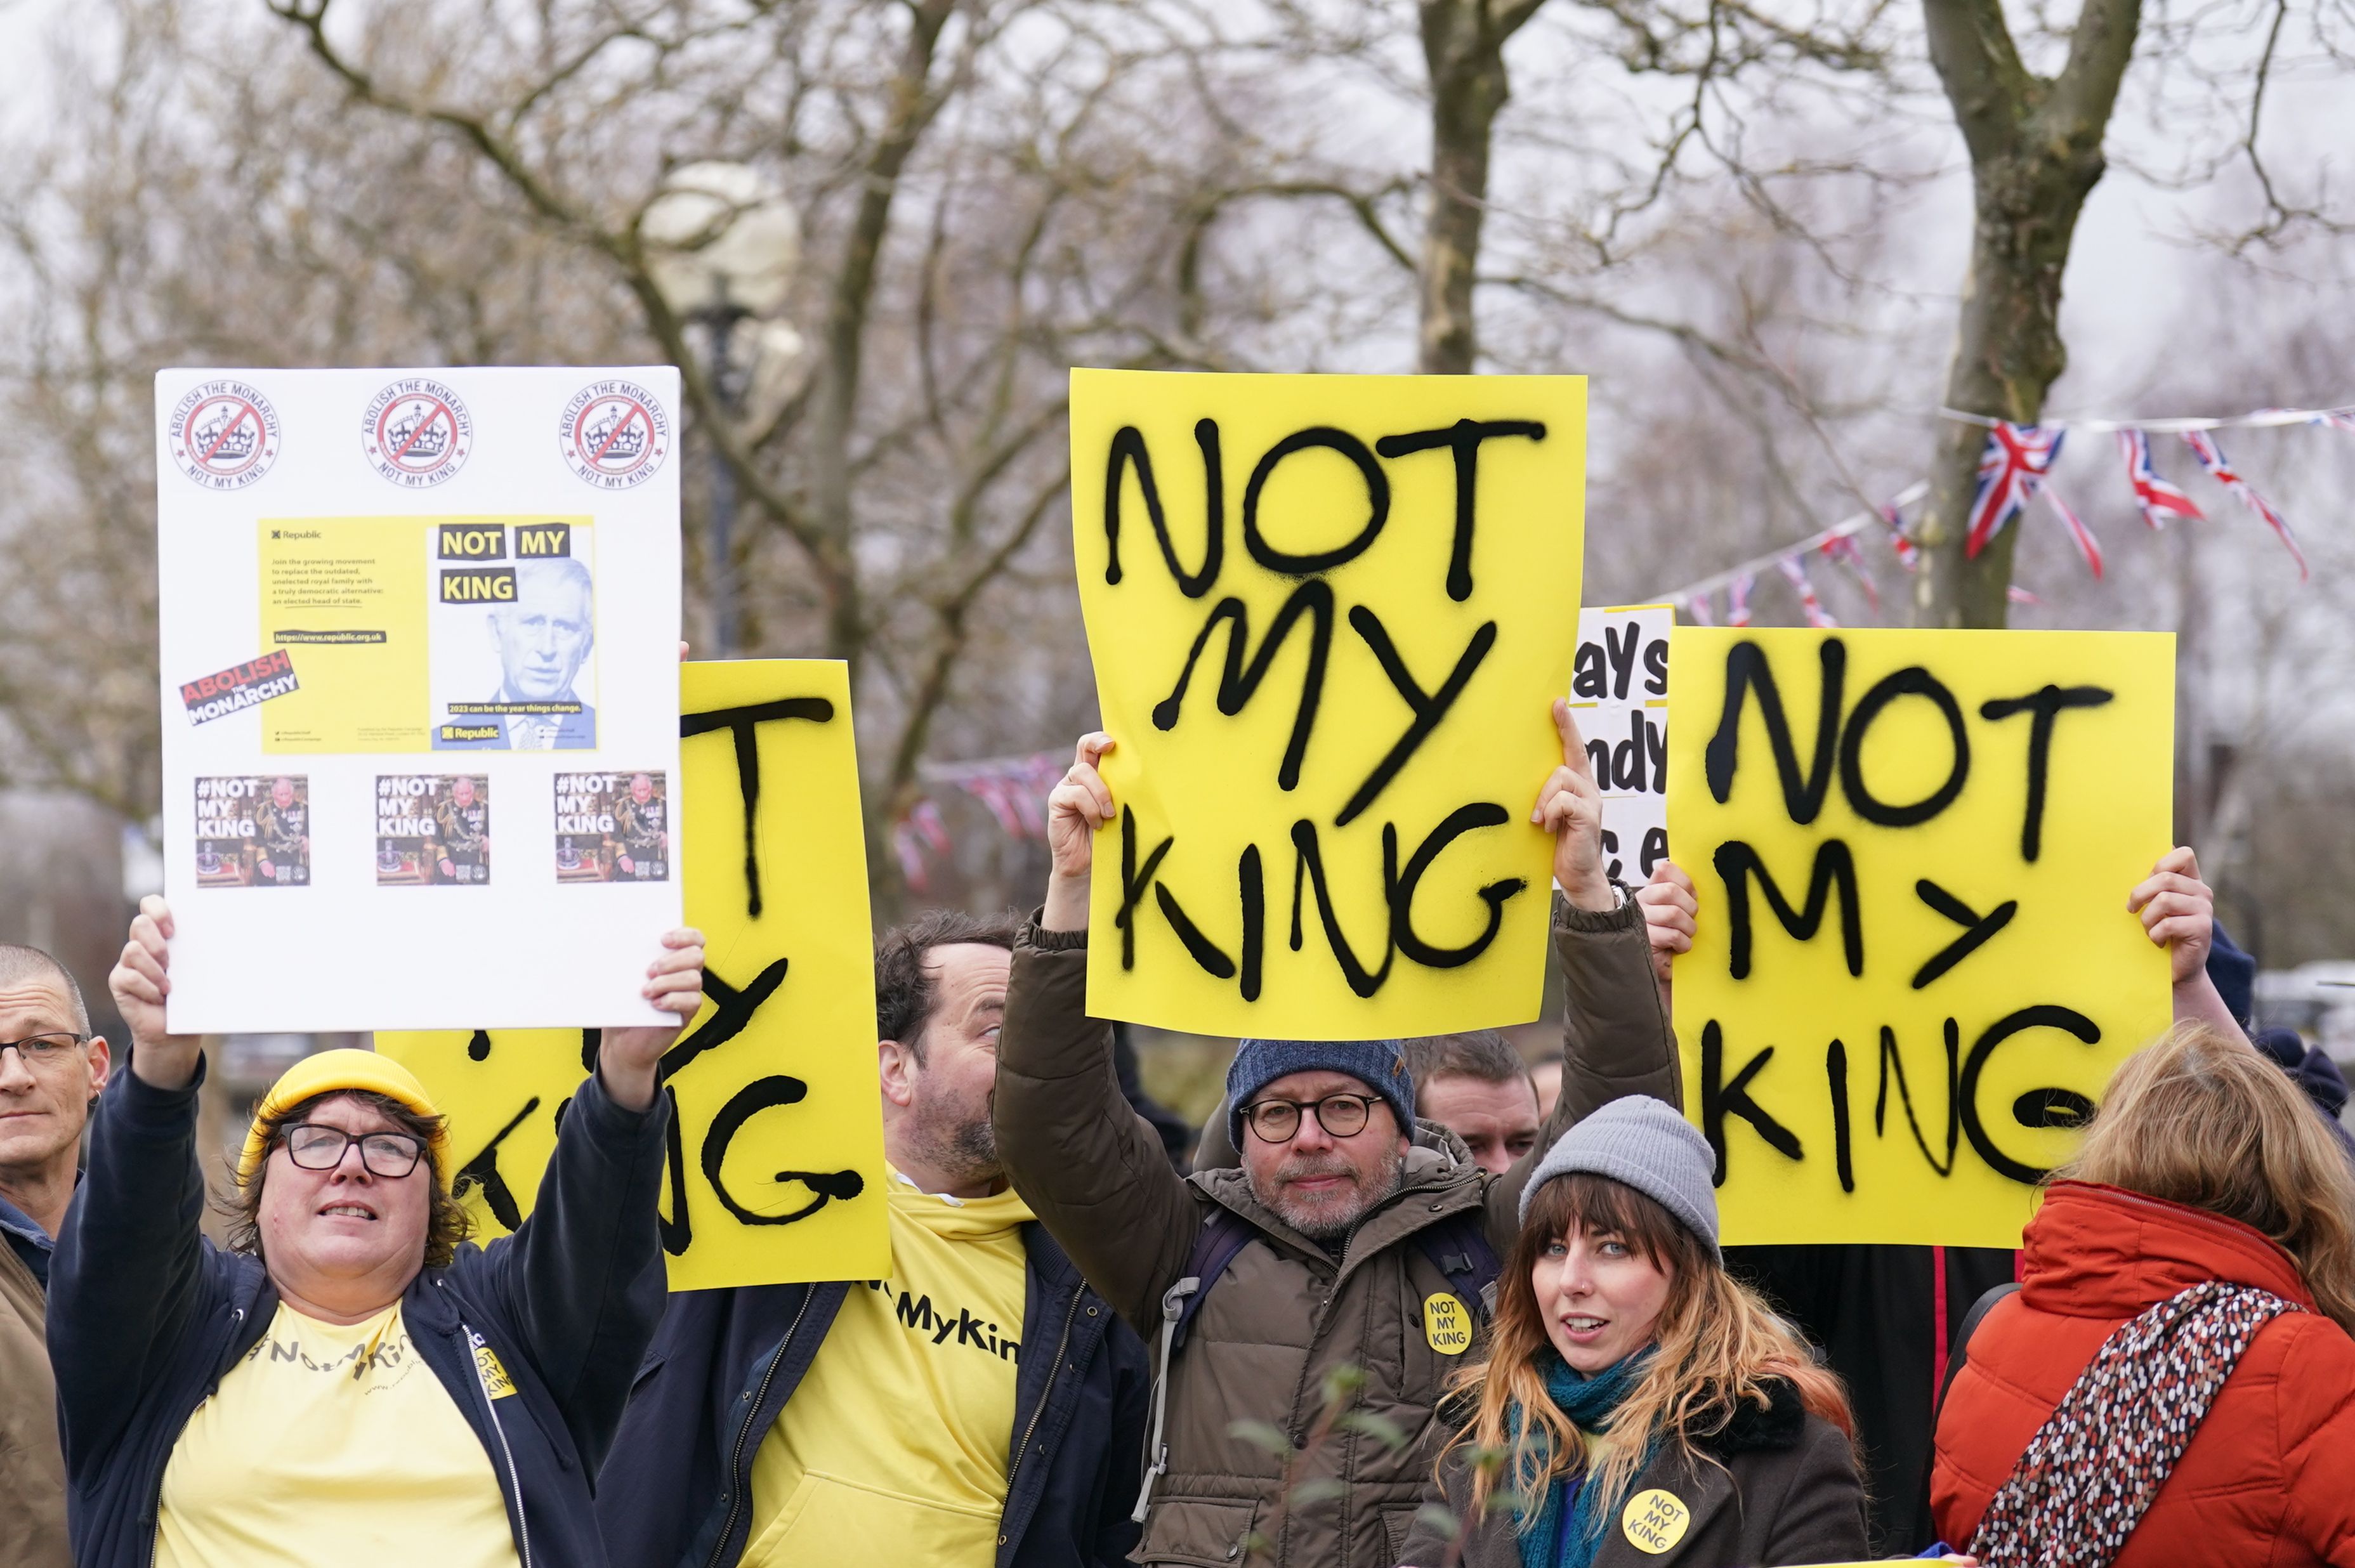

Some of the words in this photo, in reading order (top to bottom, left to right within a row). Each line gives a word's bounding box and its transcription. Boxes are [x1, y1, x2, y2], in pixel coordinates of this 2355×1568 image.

[171, 389, 202, 438] ABOLISH
[203, 382, 226, 396] THE
[232, 384, 277, 438] MONARCHY
[364, 388, 396, 434] ABOLISH
[398, 381, 421, 393] THE
[425, 382, 469, 436] MONARCHY
[562, 389, 591, 438] ABOLISH
[593, 382, 615, 396] THE
[620, 383, 667, 436] MONARCHY
[187, 465, 211, 484] NOT
[214, 477, 232, 487] MY
[237, 464, 265, 485] KING
[379, 462, 402, 481] NOT
[405, 475, 424, 485] MY
[429, 462, 456, 483] KING
[578, 465, 601, 483] NOT
[605, 476, 622, 487] MY
[627, 462, 654, 485] KING
[1105, 417, 1545, 601] NOT
[283, 530, 322, 540] Republic
[442, 531, 502, 555] NOT
[521, 530, 565, 554] MY
[443, 576, 513, 600] KING
[275, 633, 381, 643] https://www.republic.org.uk
[184, 651, 291, 703] ABOLISH
[188, 674, 296, 725] MONARCHY
[231, 684, 247, 694] THE
[509, 705, 525, 714] year
[527, 704, 550, 714] things
[551, 704, 581, 713] change.
[1152, 578, 1497, 827] MY
[455, 727, 499, 740] Republic
[1705, 637, 2115, 863] NOT
[197, 779, 258, 798] #NOT
[378, 777, 438, 796] #NOT
[556, 775, 617, 794] #NOT
[197, 799, 232, 818] MY
[379, 797, 413, 816] MY
[556, 795, 591, 814] MY
[198, 819, 256, 837] KING
[379, 817, 436, 836] KING
[557, 815, 615, 833] KING
[1115, 801, 1528, 1002] KING
[1713, 839, 2017, 990] MY
[1702, 1005, 2102, 1194] KING
[1429, 1301, 1455, 1314] NOT
[1436, 1316, 1455, 1330] MY
[1433, 1331, 1466, 1346] KING
[482, 1364, 501, 1383] MY
[1650, 1494, 1684, 1521] NOT
[1644, 1510, 1671, 1531] MY
[1628, 1519, 1667, 1549] KING
